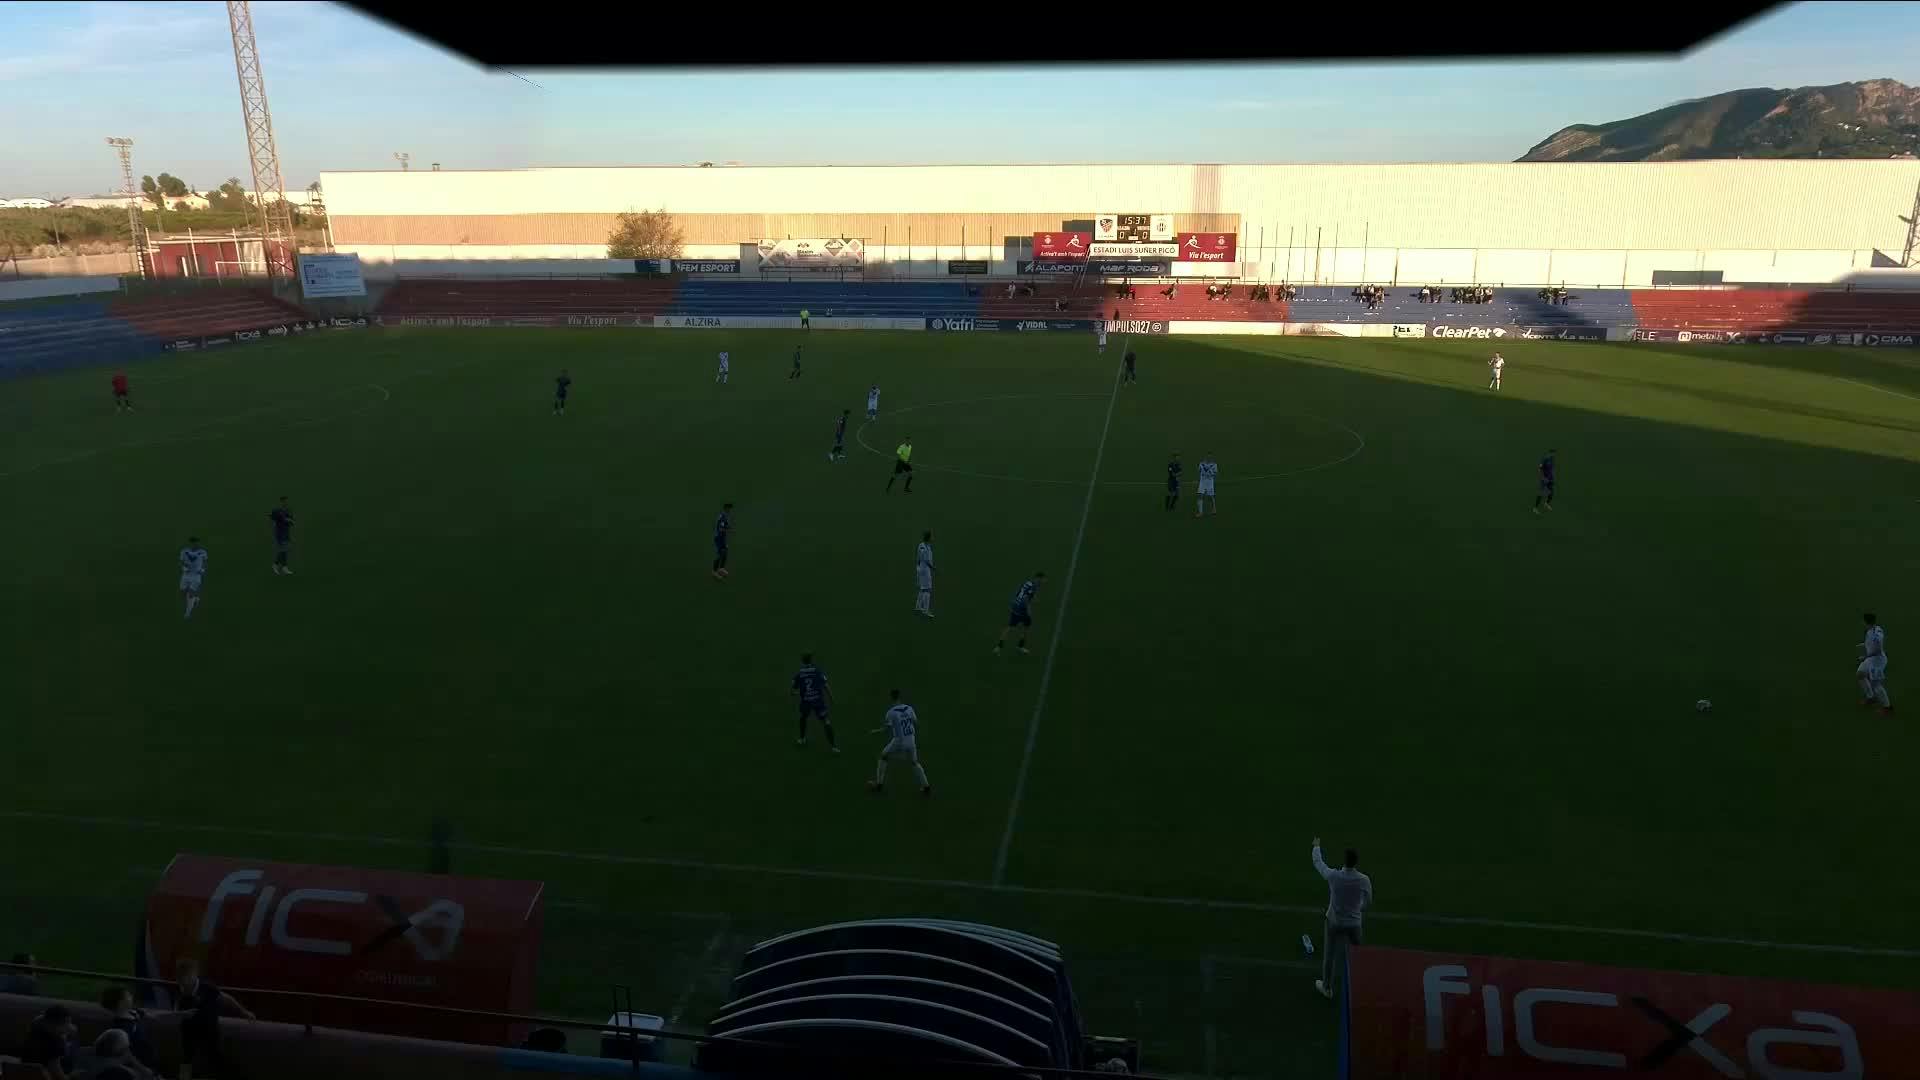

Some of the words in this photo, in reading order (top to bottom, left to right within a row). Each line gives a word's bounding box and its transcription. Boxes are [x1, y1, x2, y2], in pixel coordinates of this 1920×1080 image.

[1124, 216, 1146, 224] 15:37
[681, 264, 698, 272] FEM
[700, 264, 736, 272] ESPORT
[684, 317, 721, 326] ALZIRA
[944, 319, 974, 331] Yafri
[1104, 320, 1150, 334] IMPULSO27
[1433, 326, 1491, 339] ClearPet
[1881, 335, 1912, 344] CMA
